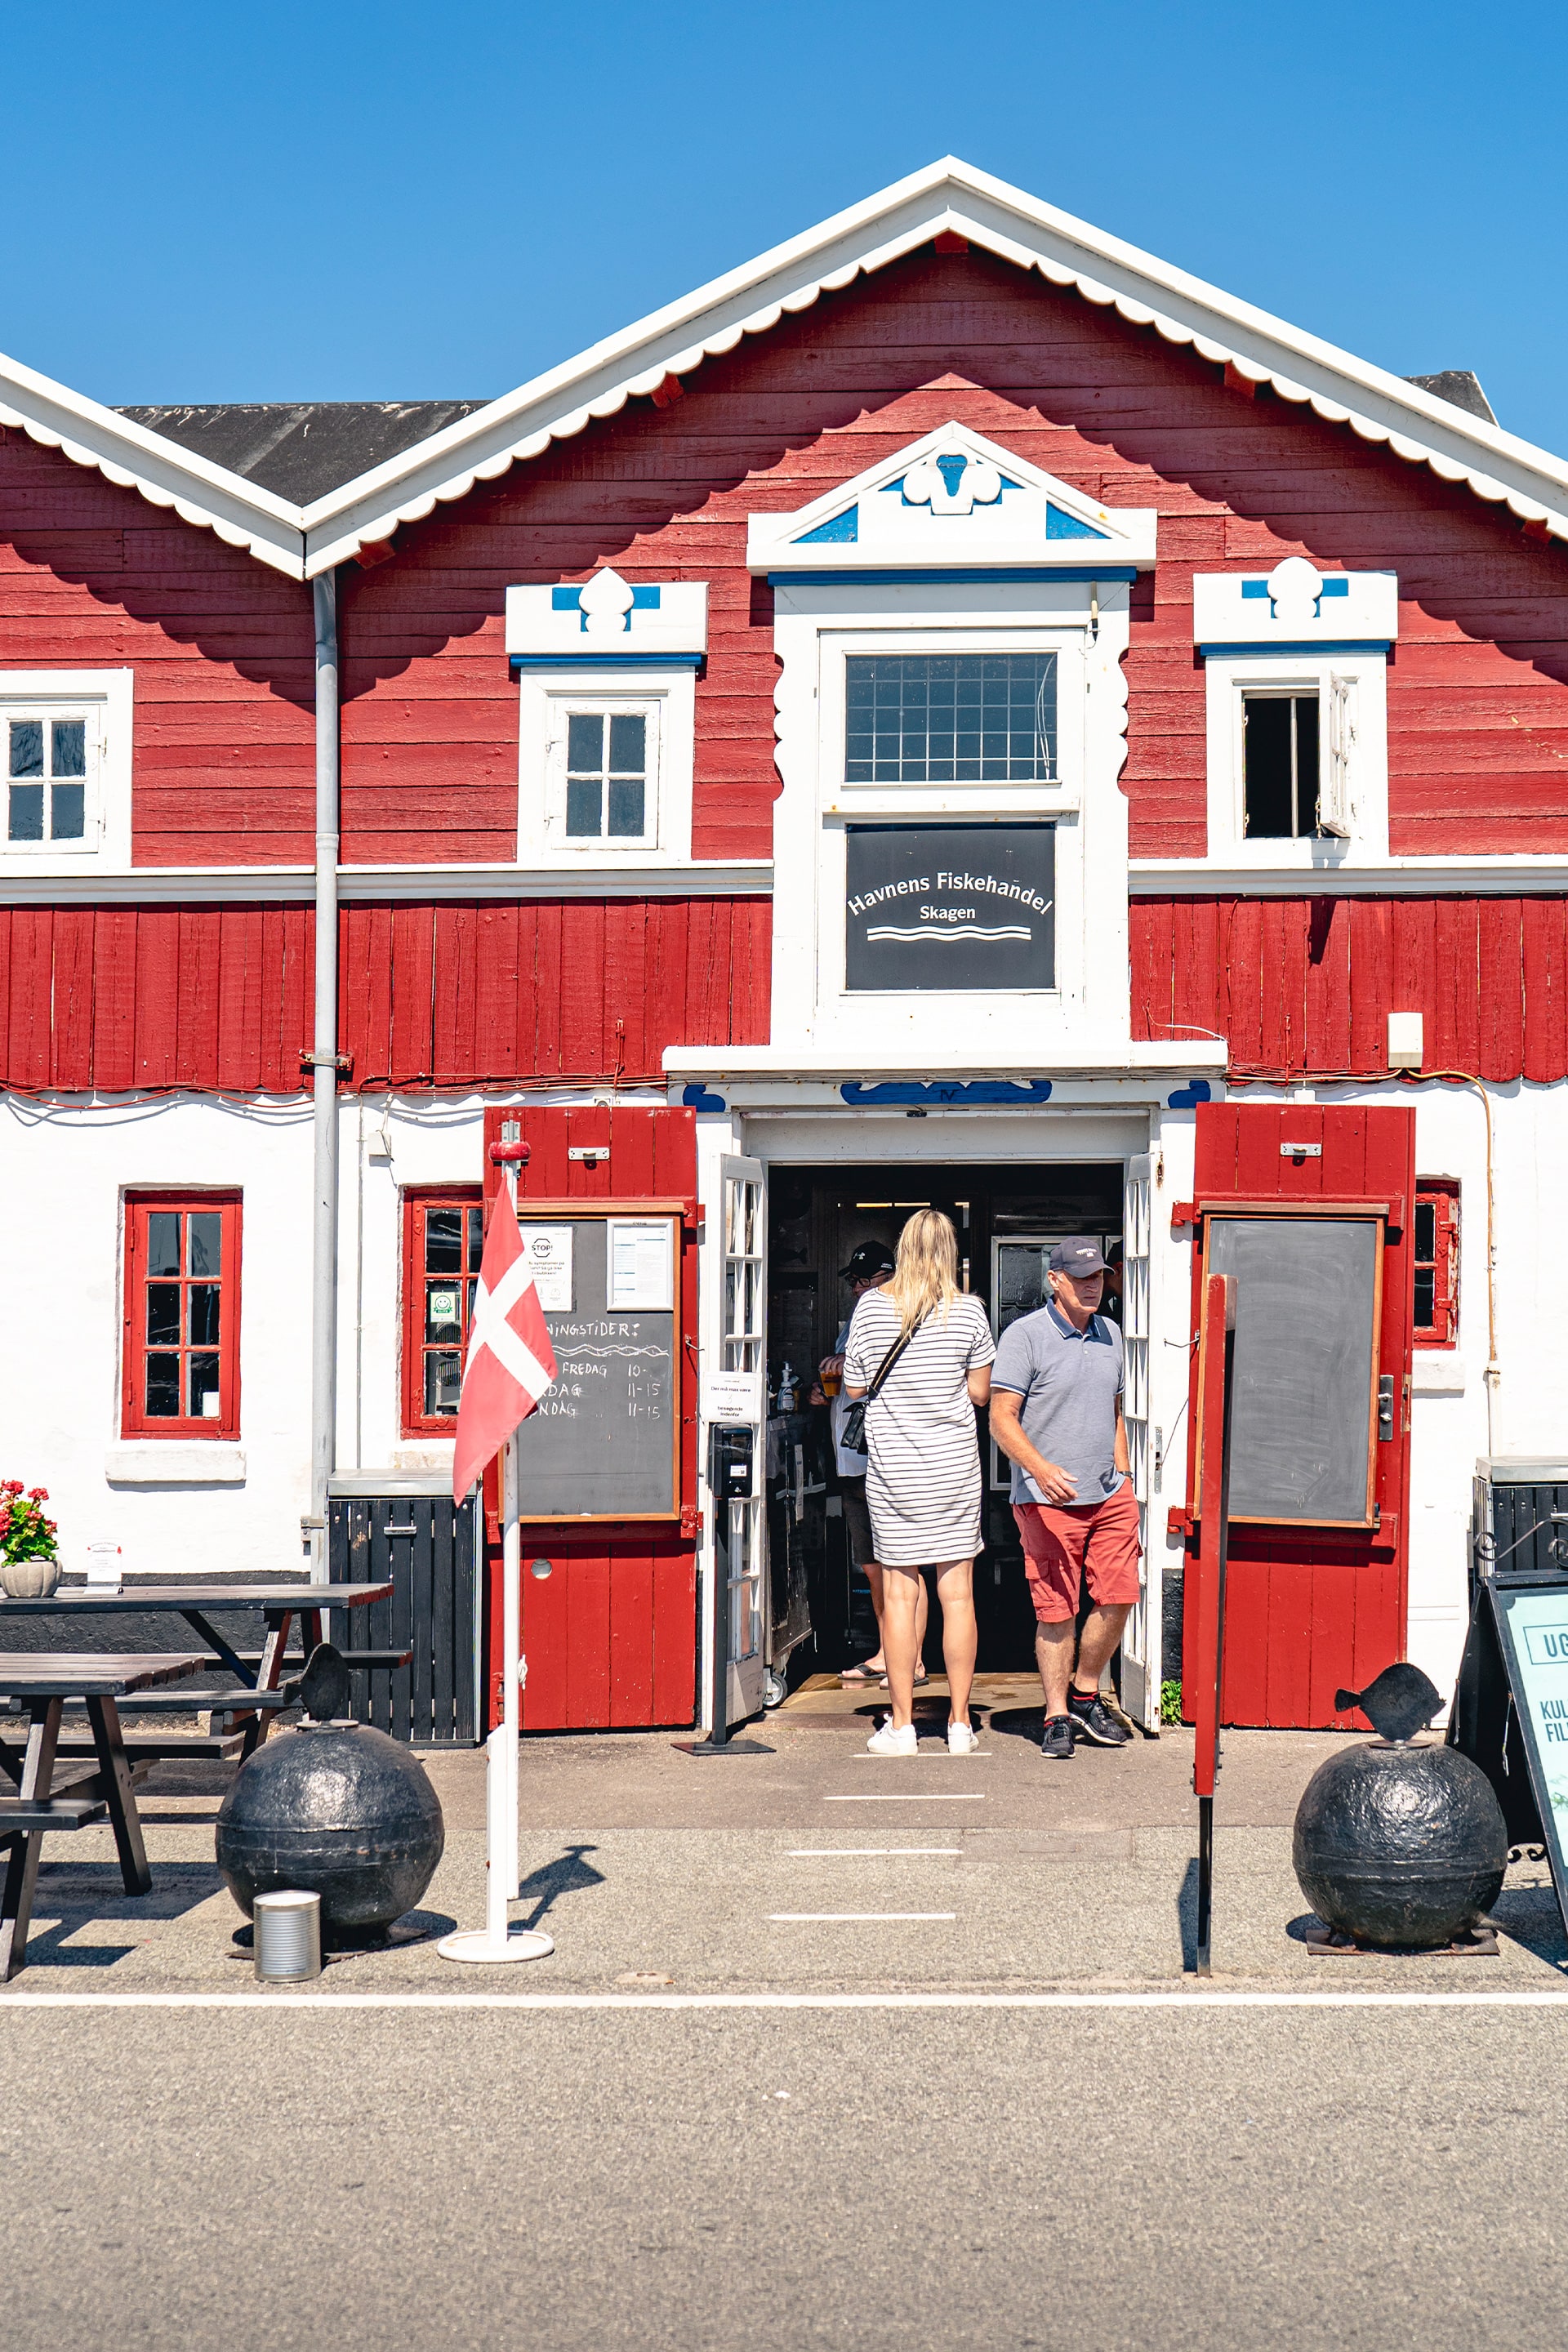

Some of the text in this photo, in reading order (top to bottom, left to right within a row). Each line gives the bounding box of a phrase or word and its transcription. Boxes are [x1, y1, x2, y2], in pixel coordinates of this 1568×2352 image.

[847, 872, 1054, 916] Havnens Fiskehandel
[920, 905, 976, 922] Skagen
[563, 1361, 607, 1378] FREDAG
[542, 1383, 581, 1398] DAG
[529, 1401, 576, 1419] NDAG
[1539, 1699, 1568, 1720] KUL
[1544, 1722, 1568, 1742] FIL
